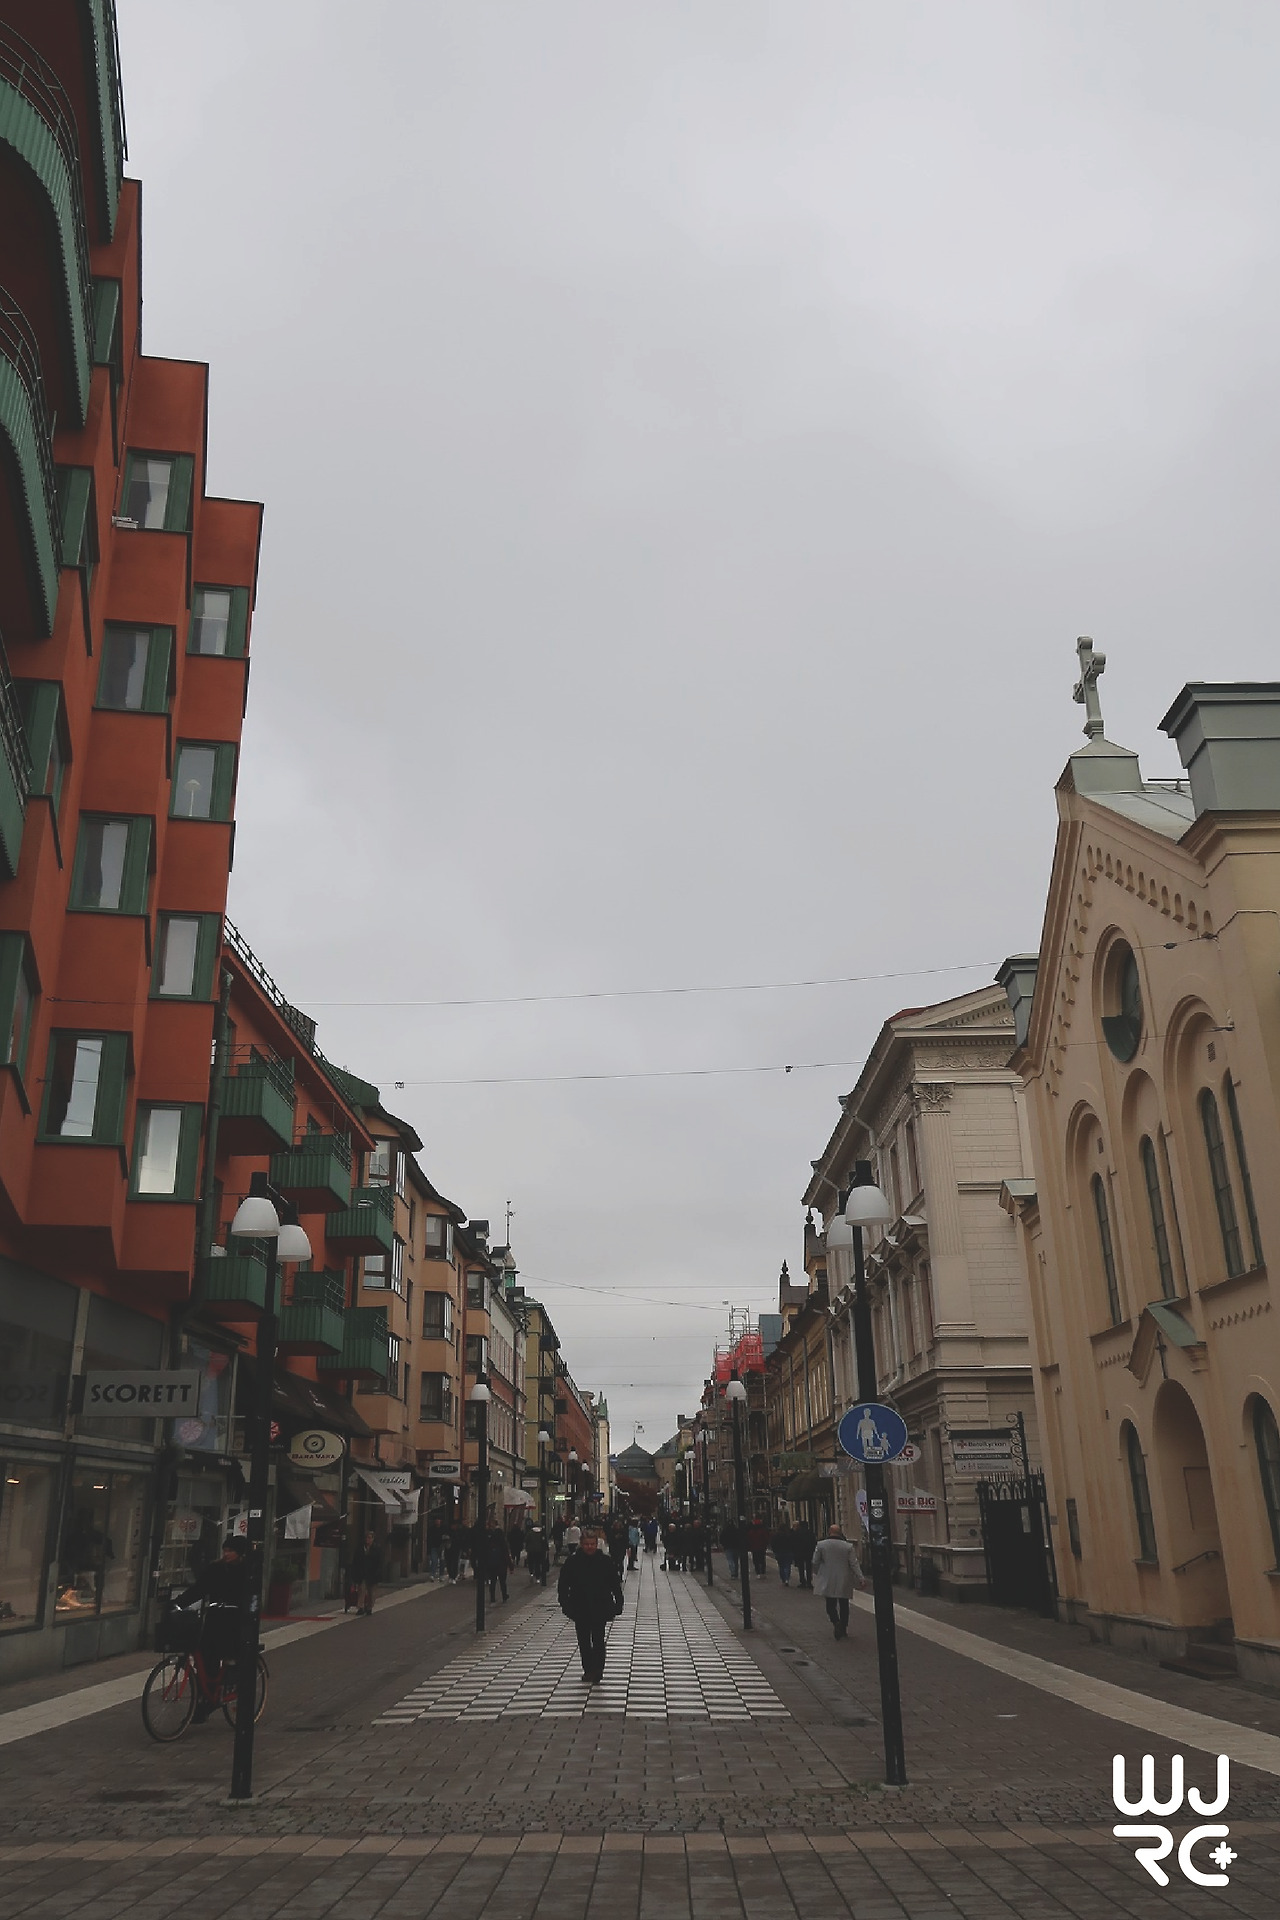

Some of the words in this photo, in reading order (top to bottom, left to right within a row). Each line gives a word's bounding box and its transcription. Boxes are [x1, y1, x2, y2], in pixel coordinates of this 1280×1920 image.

[91, 1384, 192, 1402] SCORETT
[898, 1497, 915, 1506] BIG
[918, 1497, 935, 1506] BIG
